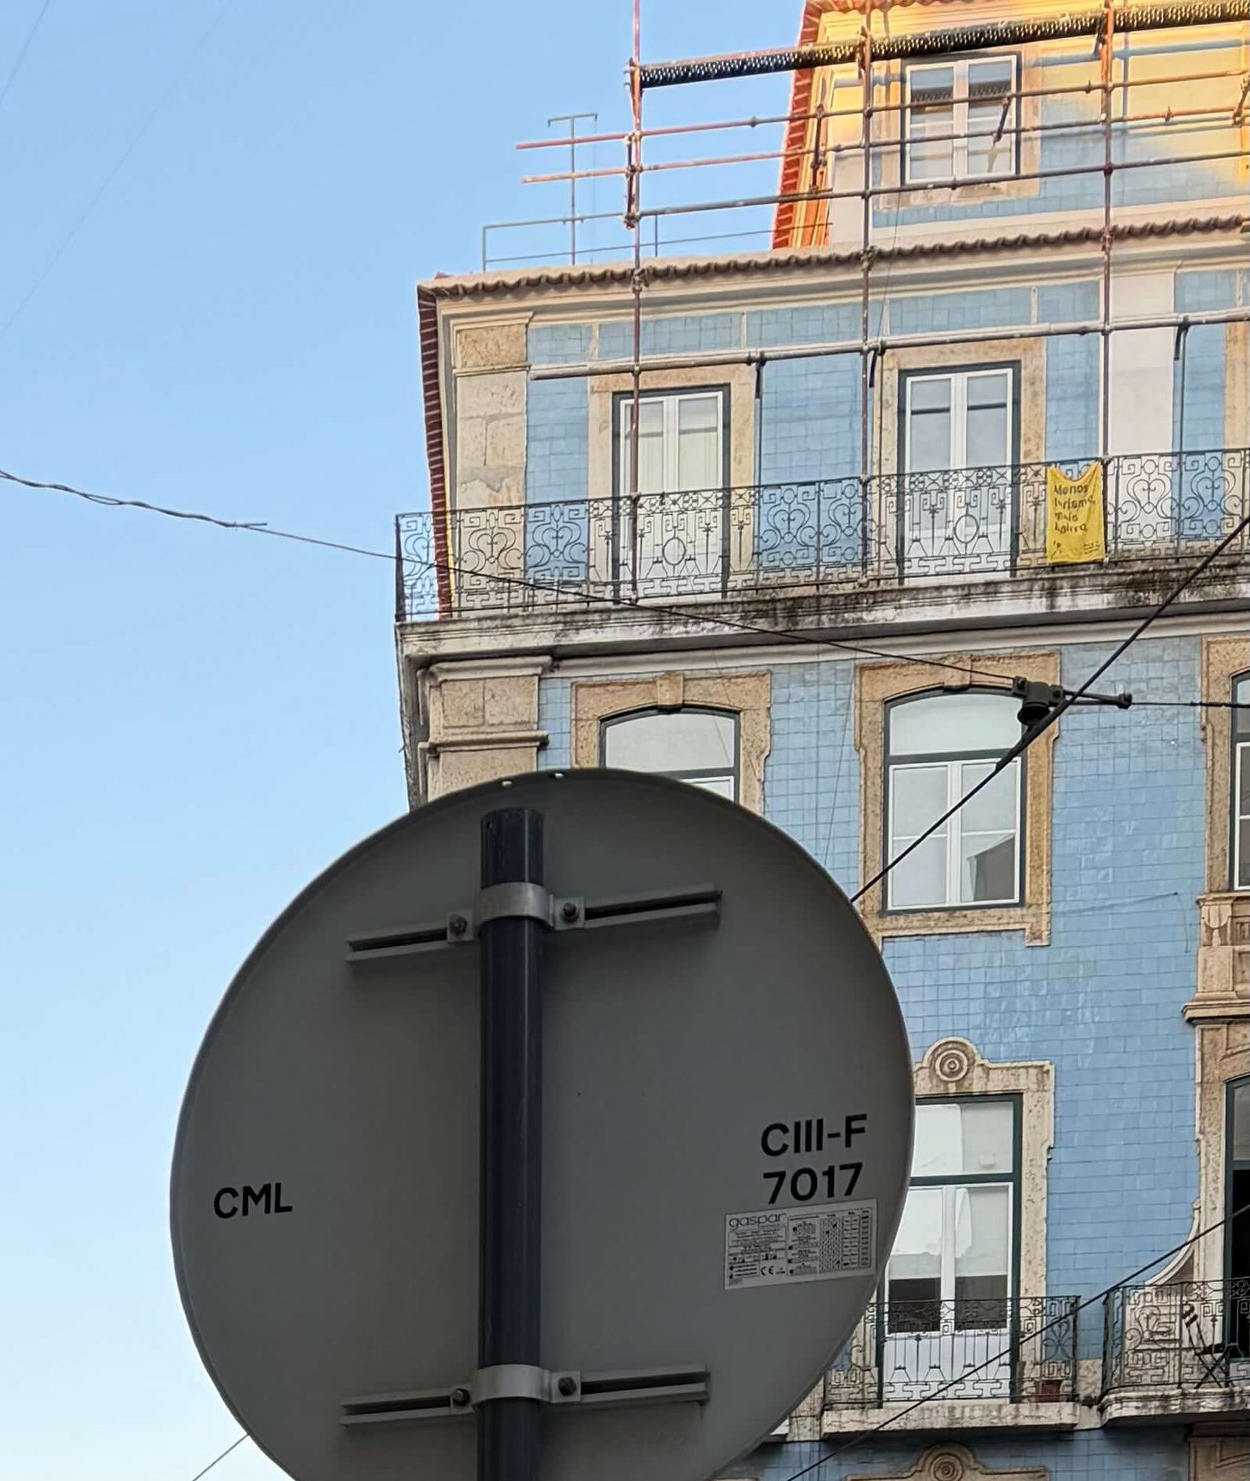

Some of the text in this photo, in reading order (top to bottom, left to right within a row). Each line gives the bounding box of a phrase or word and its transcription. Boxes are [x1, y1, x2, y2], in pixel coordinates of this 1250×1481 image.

[761, 1113, 868, 1157] CIII-F
[214, 1182, 293, 1219] CML
[763, 1162, 863, 1205] 7017
[729, 1212, 787, 1232] gaspar
